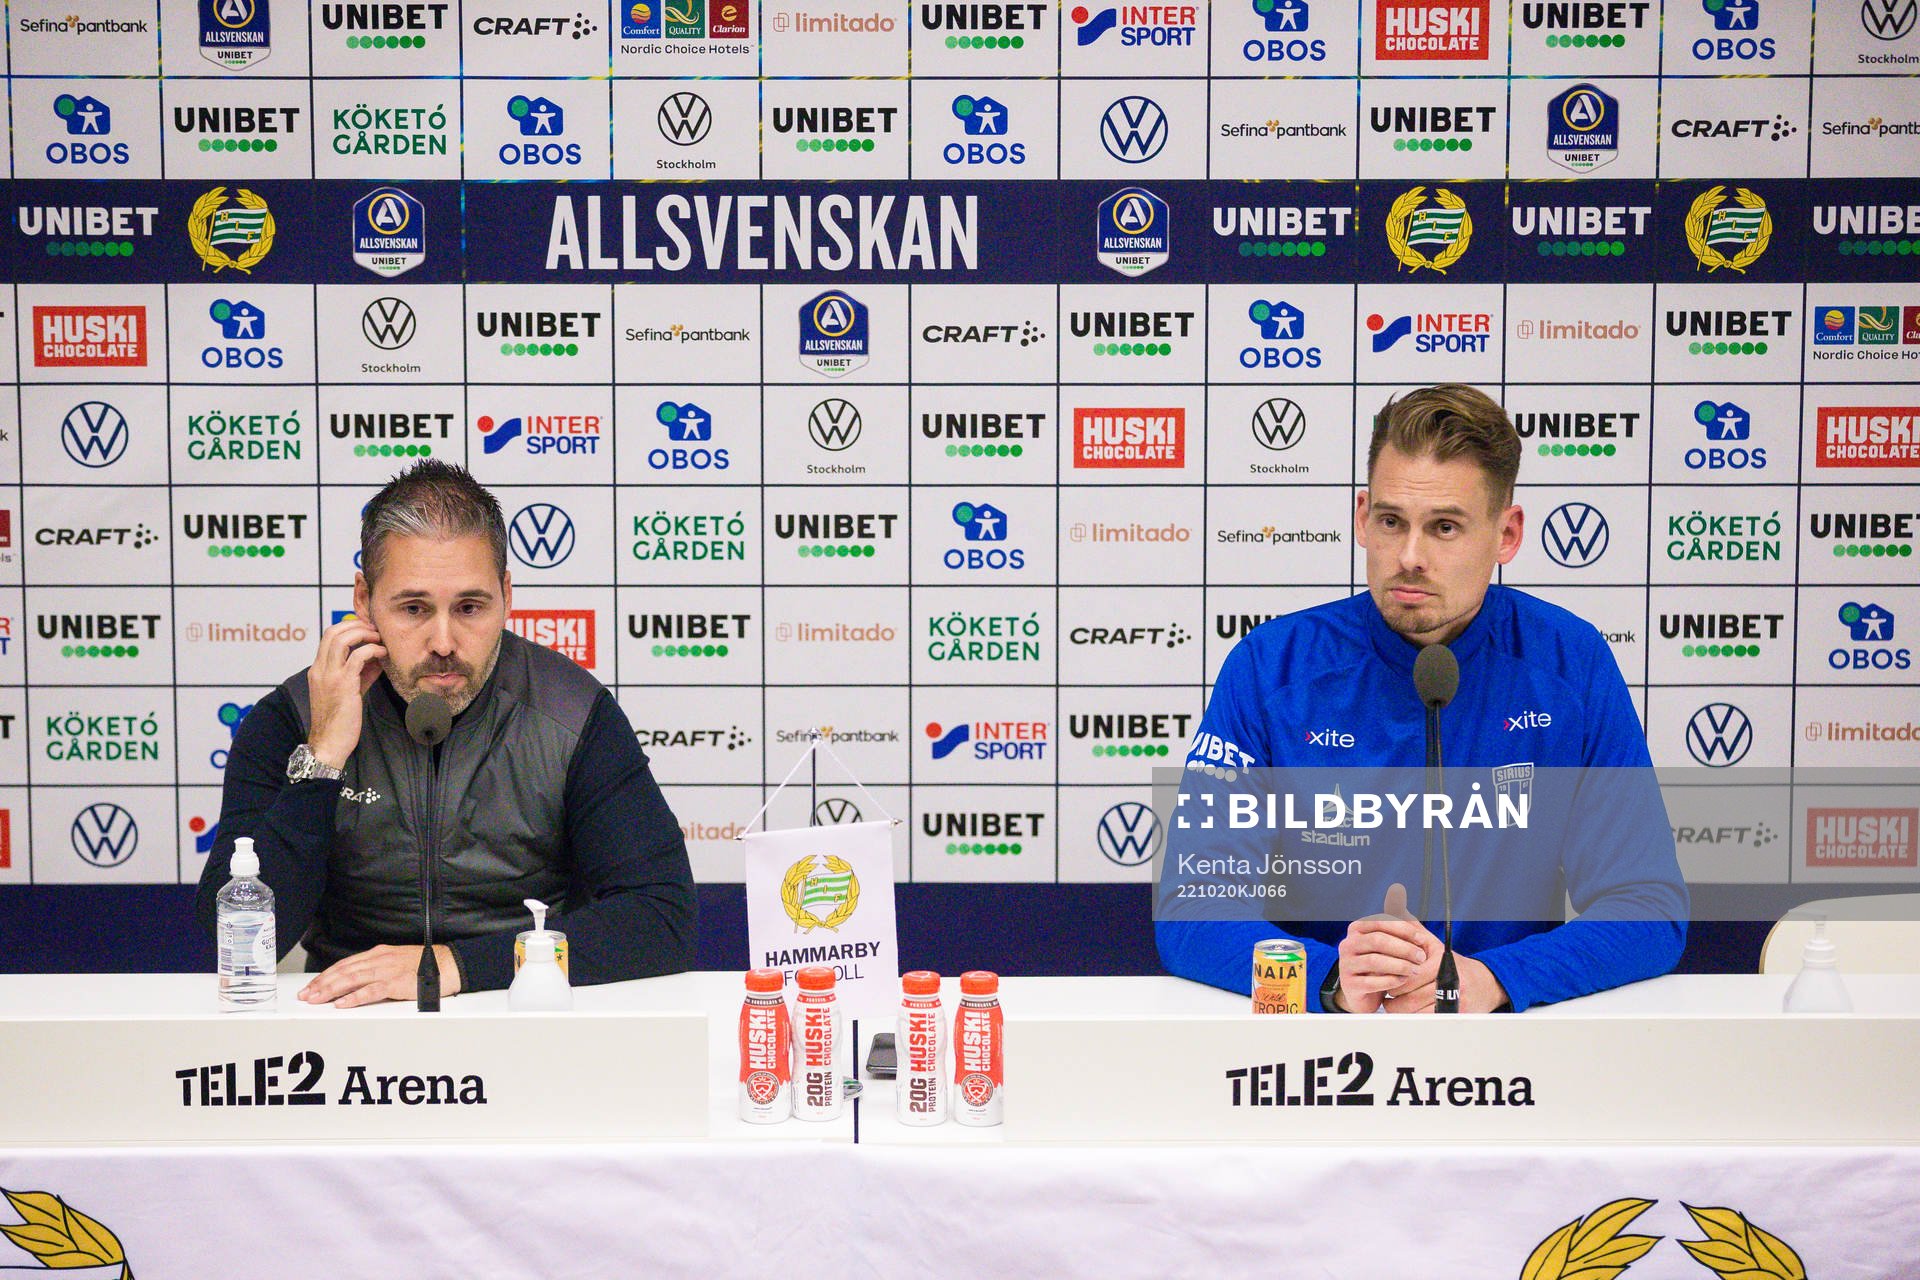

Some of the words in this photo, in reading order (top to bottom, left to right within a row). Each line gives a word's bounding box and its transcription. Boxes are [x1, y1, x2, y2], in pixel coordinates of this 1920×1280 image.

[20, 18, 69, 33] Sefina
[74, 16, 148, 36] pantbank
[322, 3, 449, 30] UNIBET
[473, 16, 571, 36] CRAFT
[795, 12, 895, 33] limitado
[921, 4, 1048, 31] UNIBET
[1122, 5, 1196, 26] INTER
[1385, 7, 1480, 36] HUSKI
[1522, 2, 1650, 29] UNIBET
[205, 31, 264, 43] ALLSVENSKAN
[622, 25, 660, 35] Comfort
[668, 26, 702, 36] QUALITY
[712, 24, 746, 33] Clarion
[1120, 26, 1196, 47] SPORT
[621, 44, 662, 54] Nordic
[664, 44, 706, 54] Choice
[708, 44, 750, 54] Hotels
[1242, 39, 1326, 62] OBOS
[1385, 32, 1480, 51] CHOCOLATE
[1692, 37, 1776, 61] OBOS
[217, 50, 253, 59] UNIBET
[1858, 53, 1920, 64] Stockholm
[174, 106, 300, 134] UNIBET
[772, 107, 898, 134] UNIBET
[1370, 106, 1497, 133] UNIBET
[1671, 119, 1770, 138] CRAFT
[1822, 121, 1871, 135] Sefina
[1878, 119, 1920, 138] pantb
[332, 130, 447, 156] GÅRDEN
[1220, 123, 1269, 137] Sefina
[1276, 123, 1347, 140] pantbank
[1553, 134, 1612, 146] ALLSVENSKAN
[45, 142, 130, 165] OBOS
[498, 143, 582, 166] OBOS
[656, 159, 716, 169] Stockholm
[943, 142, 1026, 165] OBOS
[1564, 153, 1600, 162] UNIBET
[19, 206, 159, 236] UNIBET
[1213, 207, 1352, 236] UNIBET
[1512, 206, 1652, 236] UNIBET
[1813, 205, 1920, 235] UNIBE
[359, 237, 418, 249] ALLSVENSKAN
[545, 194, 978, 271] ALLSVENSKAN
[1103, 237, 1162, 249] ALLSVENSKAN
[371, 257, 407, 265] UNIBET
[1115, 256, 1151, 265] UNIBET
[42, 315, 138, 343] HUSKI
[477, 312, 601, 338] UNIBET
[922, 325, 1019, 344] CRAFT
[1070, 311, 1195, 338] UNIBET
[1417, 313, 1490, 333] INTER
[1539, 319, 1639, 340] limitado
[1666, 310, 1792, 337] UNIBET
[625, 327, 673, 342] Sefina
[679, 326, 750, 344] pantbank
[804, 339, 863, 351] ALLSVENSKAN
[1415, 333, 1491, 353] SPORT
[1815, 332, 1853, 341] Comfort
[1862, 332, 1895, 342] QUALITY
[43, 343, 138, 358] CHOCOLATE
[201, 346, 284, 369] OBOS
[1239, 346, 1322, 369] OBOS
[1813, 349, 1854, 360] Nordic
[1857, 349, 1899, 360] Choice
[361, 363, 421, 373] Stockholm
[816, 358, 852, 367] UNIBET
[330, 413, 454, 439] UNIBET
[527, 415, 600, 435] INTER
[922, 413, 1046, 439] UNIBET
[1082, 416, 1176, 444] HUSKI
[1514, 412, 1641, 439] UNIBET
[1826, 415, 1920, 444] HUSKI
[187, 436, 301, 461] GÅRDEN
[526, 435, 601, 455] SPORT
[1082, 445, 1176, 460] CHOCOLATE
[1826, 444, 1920, 459] CHOCOLATE
[647, 448, 730, 470] OBOS
[806, 464, 866, 474] Stockholm
[1250, 463, 1309, 474] Stockholm
[1684, 447, 1767, 470] OBOS
[35, 527, 132, 546] CRAFT
[183, 514, 308, 539] UNIBET
[775, 514, 898, 540] UNIBET
[1092, 522, 1190, 543] limitado
[1217, 529, 1264, 543] Sefina
[1272, 529, 1341, 545] pantbank
[1810, 513, 1920, 539] UNIBE
[632, 537, 745, 561] GÅRDEN
[943, 548, 1025, 570] OBOS
[1666, 536, 1781, 561] GÅRDEN
[37, 614, 161, 640] UNIBET
[208, 623, 307, 642] limitado
[628, 614, 751, 639] UNIBET
[798, 622, 895, 642] limitado
[1069, 627, 1165, 645] CRAFT
[1659, 614, 1785, 639] UNIBET
[927, 638, 1040, 661] GÅRDEN
[1828, 648, 1911, 670] OBOS
[975, 721, 1047, 740] INTER
[1069, 714, 1192, 739] UNIBET
[1506, 708, 1553, 734] xite
[635, 729, 726, 748] CRAFT
[775, 728, 822, 744] Sefin
[829, 727, 899, 745] pantbank
[1308, 727, 1356, 749] xite
[46, 737, 159, 761] GÅRDEN
[974, 741, 1047, 760] SPORT
[1495, 764, 1533, 783] SIRIUS
[923, 813, 1045, 837] UNIBET
[1673, 826, 1753, 845] RAFT
[1816, 816, 1909, 844] HUSKI
[1300, 829, 1371, 848] stadium
[1815, 844, 1908, 859] CHOCOLATE
[765, 941, 882, 968] HAMMARBY
[783, 963, 866, 987] FOLL
[747, 1006, 768, 1071] HUSKI
[766, 1008, 778, 1070] CHOCOLATE
[804, 1006, 825, 1068] HUSKI
[822, 1006, 833, 1067] CHOCOLATE
[907, 1011, 929, 1074] HUSKI
[926, 1011, 937, 1073] CHOCOLATE
[962, 1009, 983, 1073] HUSKI
[980, 1010, 992, 1073] CHOCOLATE
[175, 1050, 326, 1107] TELE2
[337, 1065, 488, 1106] Arena
[806, 1071, 825, 1108] 20G
[823, 1070, 834, 1108] PROTEIN
[1225, 1051, 1374, 1107] TELE2
[1386, 1067, 1536, 1107] Arena
[908, 1076, 929, 1114] 20G
[927, 1076, 938, 1114] PROTEIN
